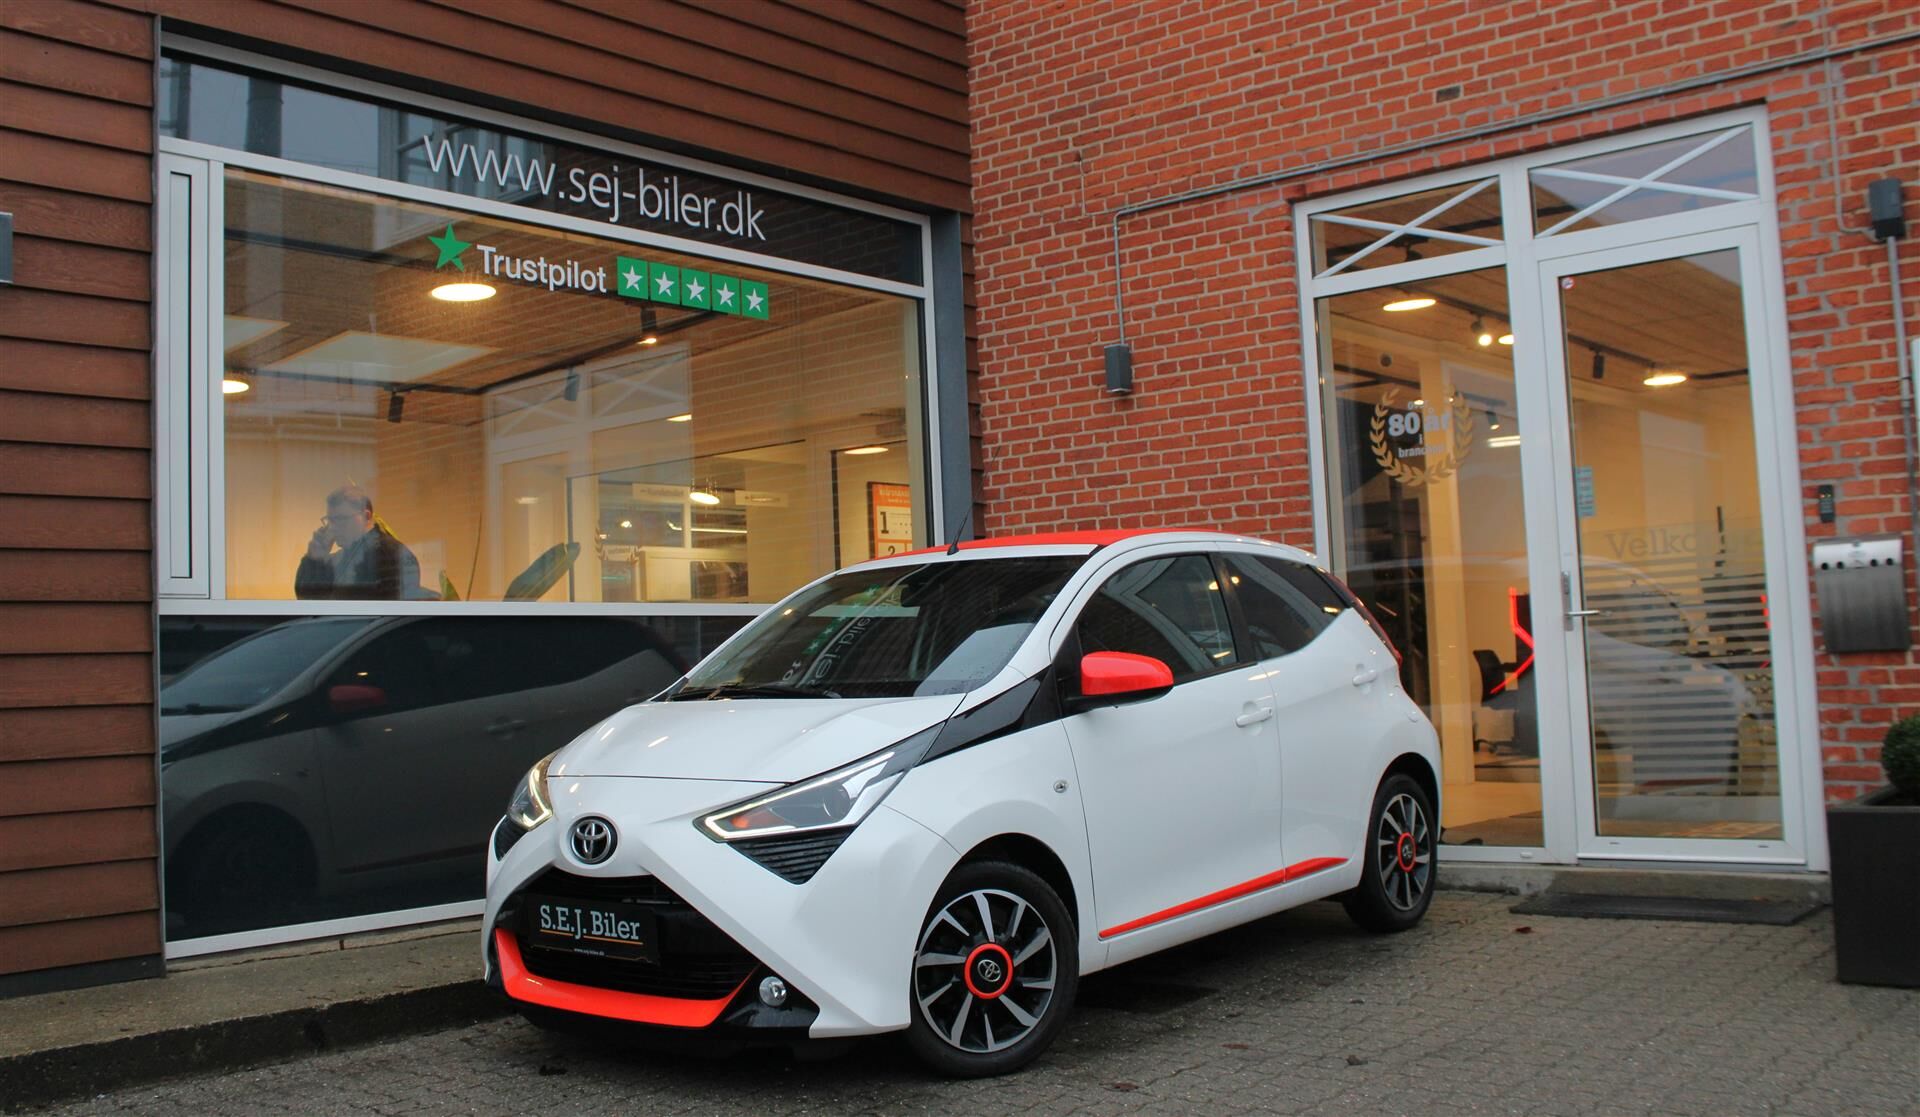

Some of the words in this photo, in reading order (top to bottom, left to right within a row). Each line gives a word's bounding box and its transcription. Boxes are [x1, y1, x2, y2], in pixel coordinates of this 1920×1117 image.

[423, 135, 766, 242] www.sej-biler.dk
[476, 244, 608, 294] Trustpilot
[1388, 411, 1421, 437] 80
[880, 511, 889, 534] 1
[540, 904, 587, 940] S.E.J.
[590, 911, 640, 940] Biler
